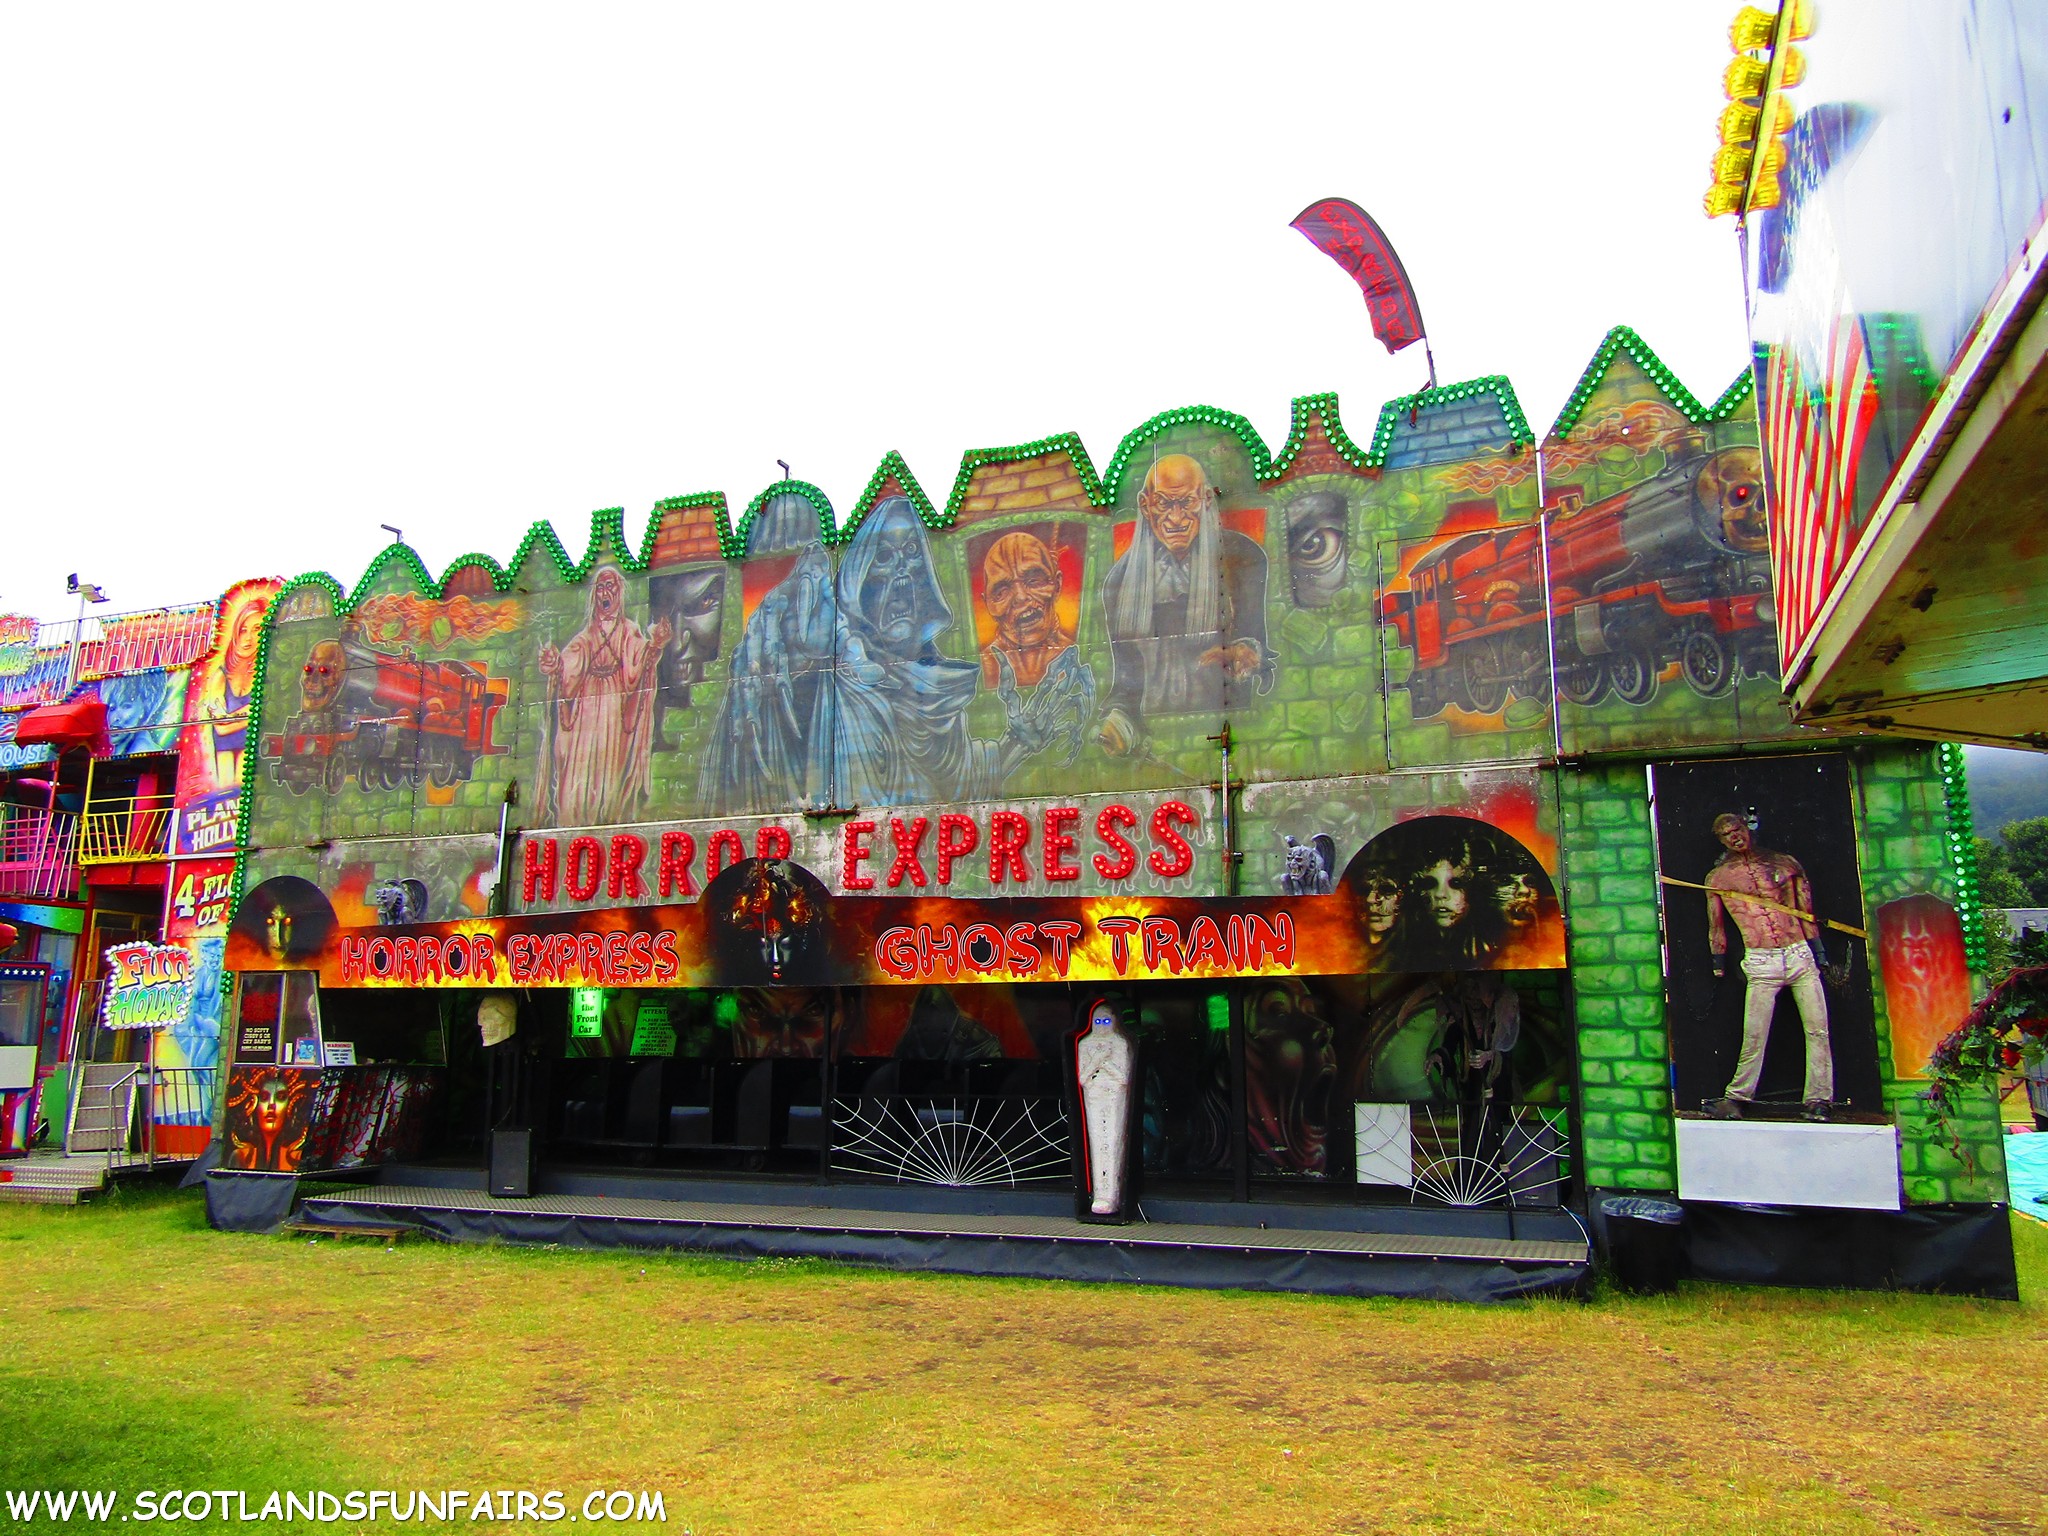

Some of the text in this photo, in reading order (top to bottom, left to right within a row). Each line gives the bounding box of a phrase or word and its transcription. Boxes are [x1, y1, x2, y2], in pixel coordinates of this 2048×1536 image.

[0, 743, 50, 767] OUSE
[843, 801, 1194, 890] EXPRESS
[174, 873, 195, 918] 4
[197, 903, 225, 926] OF
[341, 912, 1297, 984] HORROR EXPRESS GHOST TRAIN
[115, 947, 189, 989] Fun
[576, 1014, 598, 1022] Front
[581, 1003, 594, 1011] the
